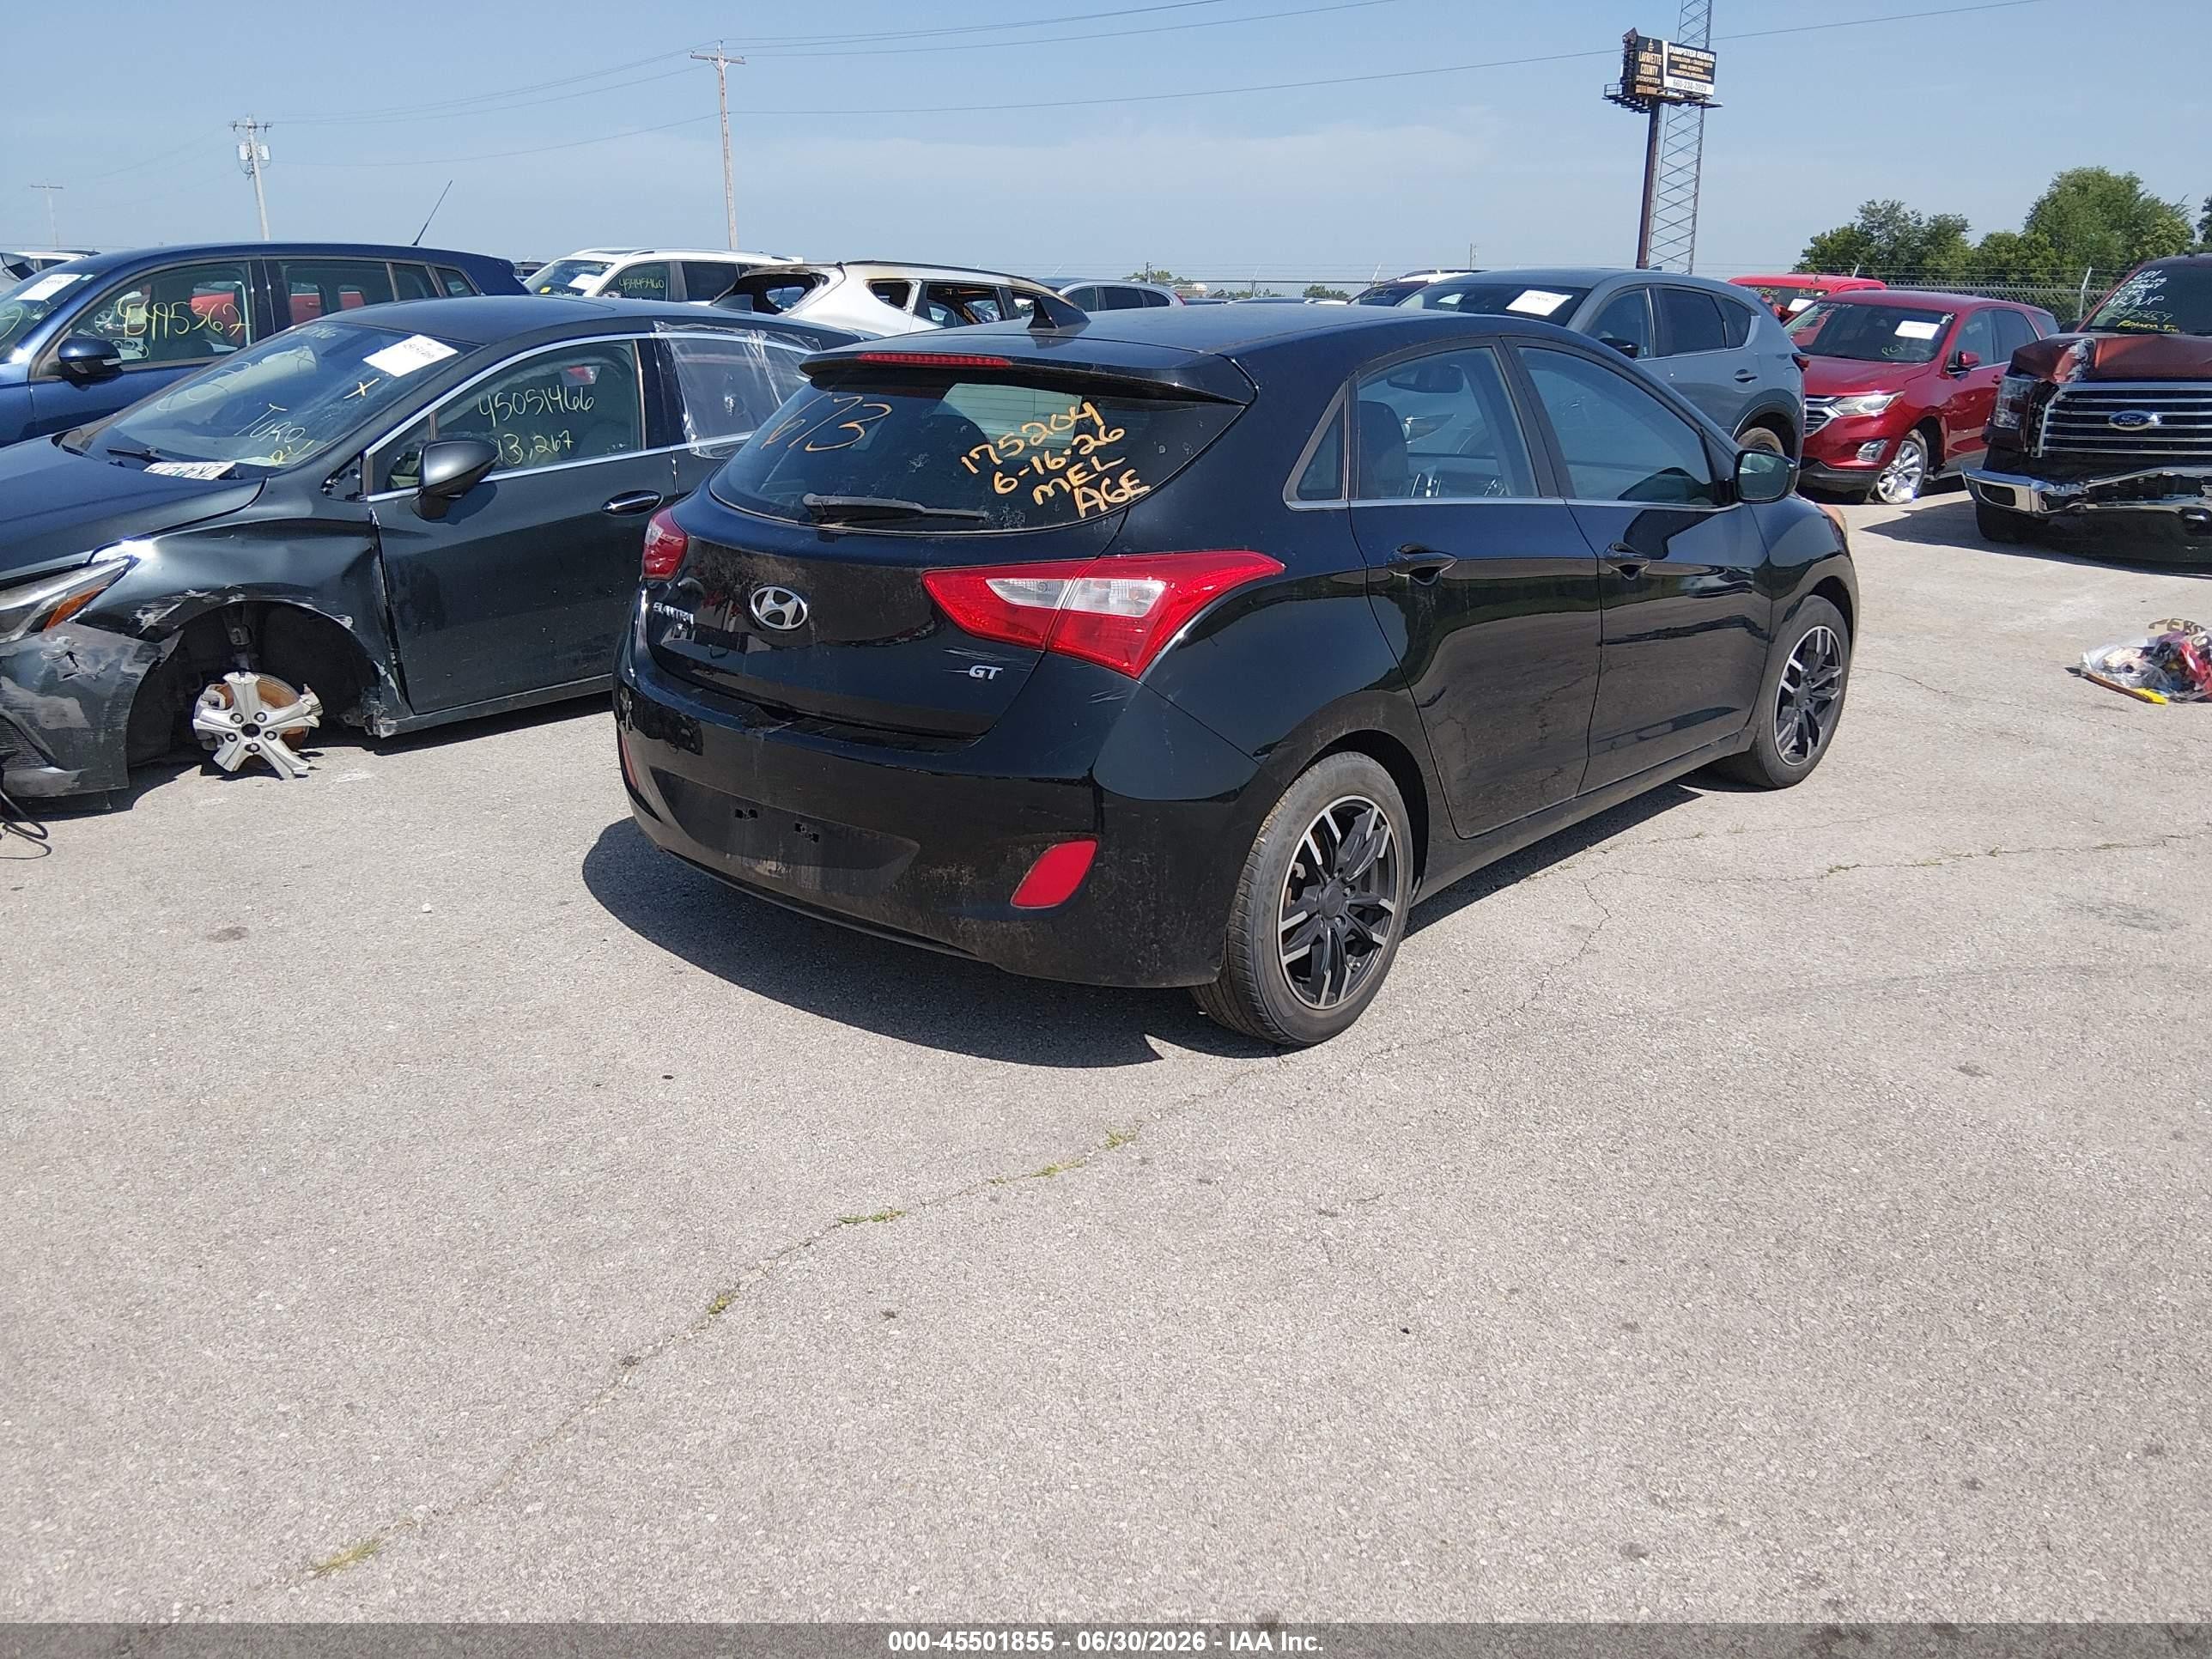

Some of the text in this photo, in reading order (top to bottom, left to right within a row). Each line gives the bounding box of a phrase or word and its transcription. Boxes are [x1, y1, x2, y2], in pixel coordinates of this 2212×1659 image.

[1640, 64, 1659, 76] COUNTY
[1668, 45, 1697, 58] DUMPSTER
[118, 300, 251, 341] 45495367
[234, 403, 306, 443] TURO
[479, 385, 594, 428] 45051466
[498, 429, 574, 465] 13,267
[994, 425, 1126, 495] 6-16-26
[1032, 456, 1127, 506] MEL
[1073, 468, 1152, 519] AGE
[969, 665, 1004, 680] GT
